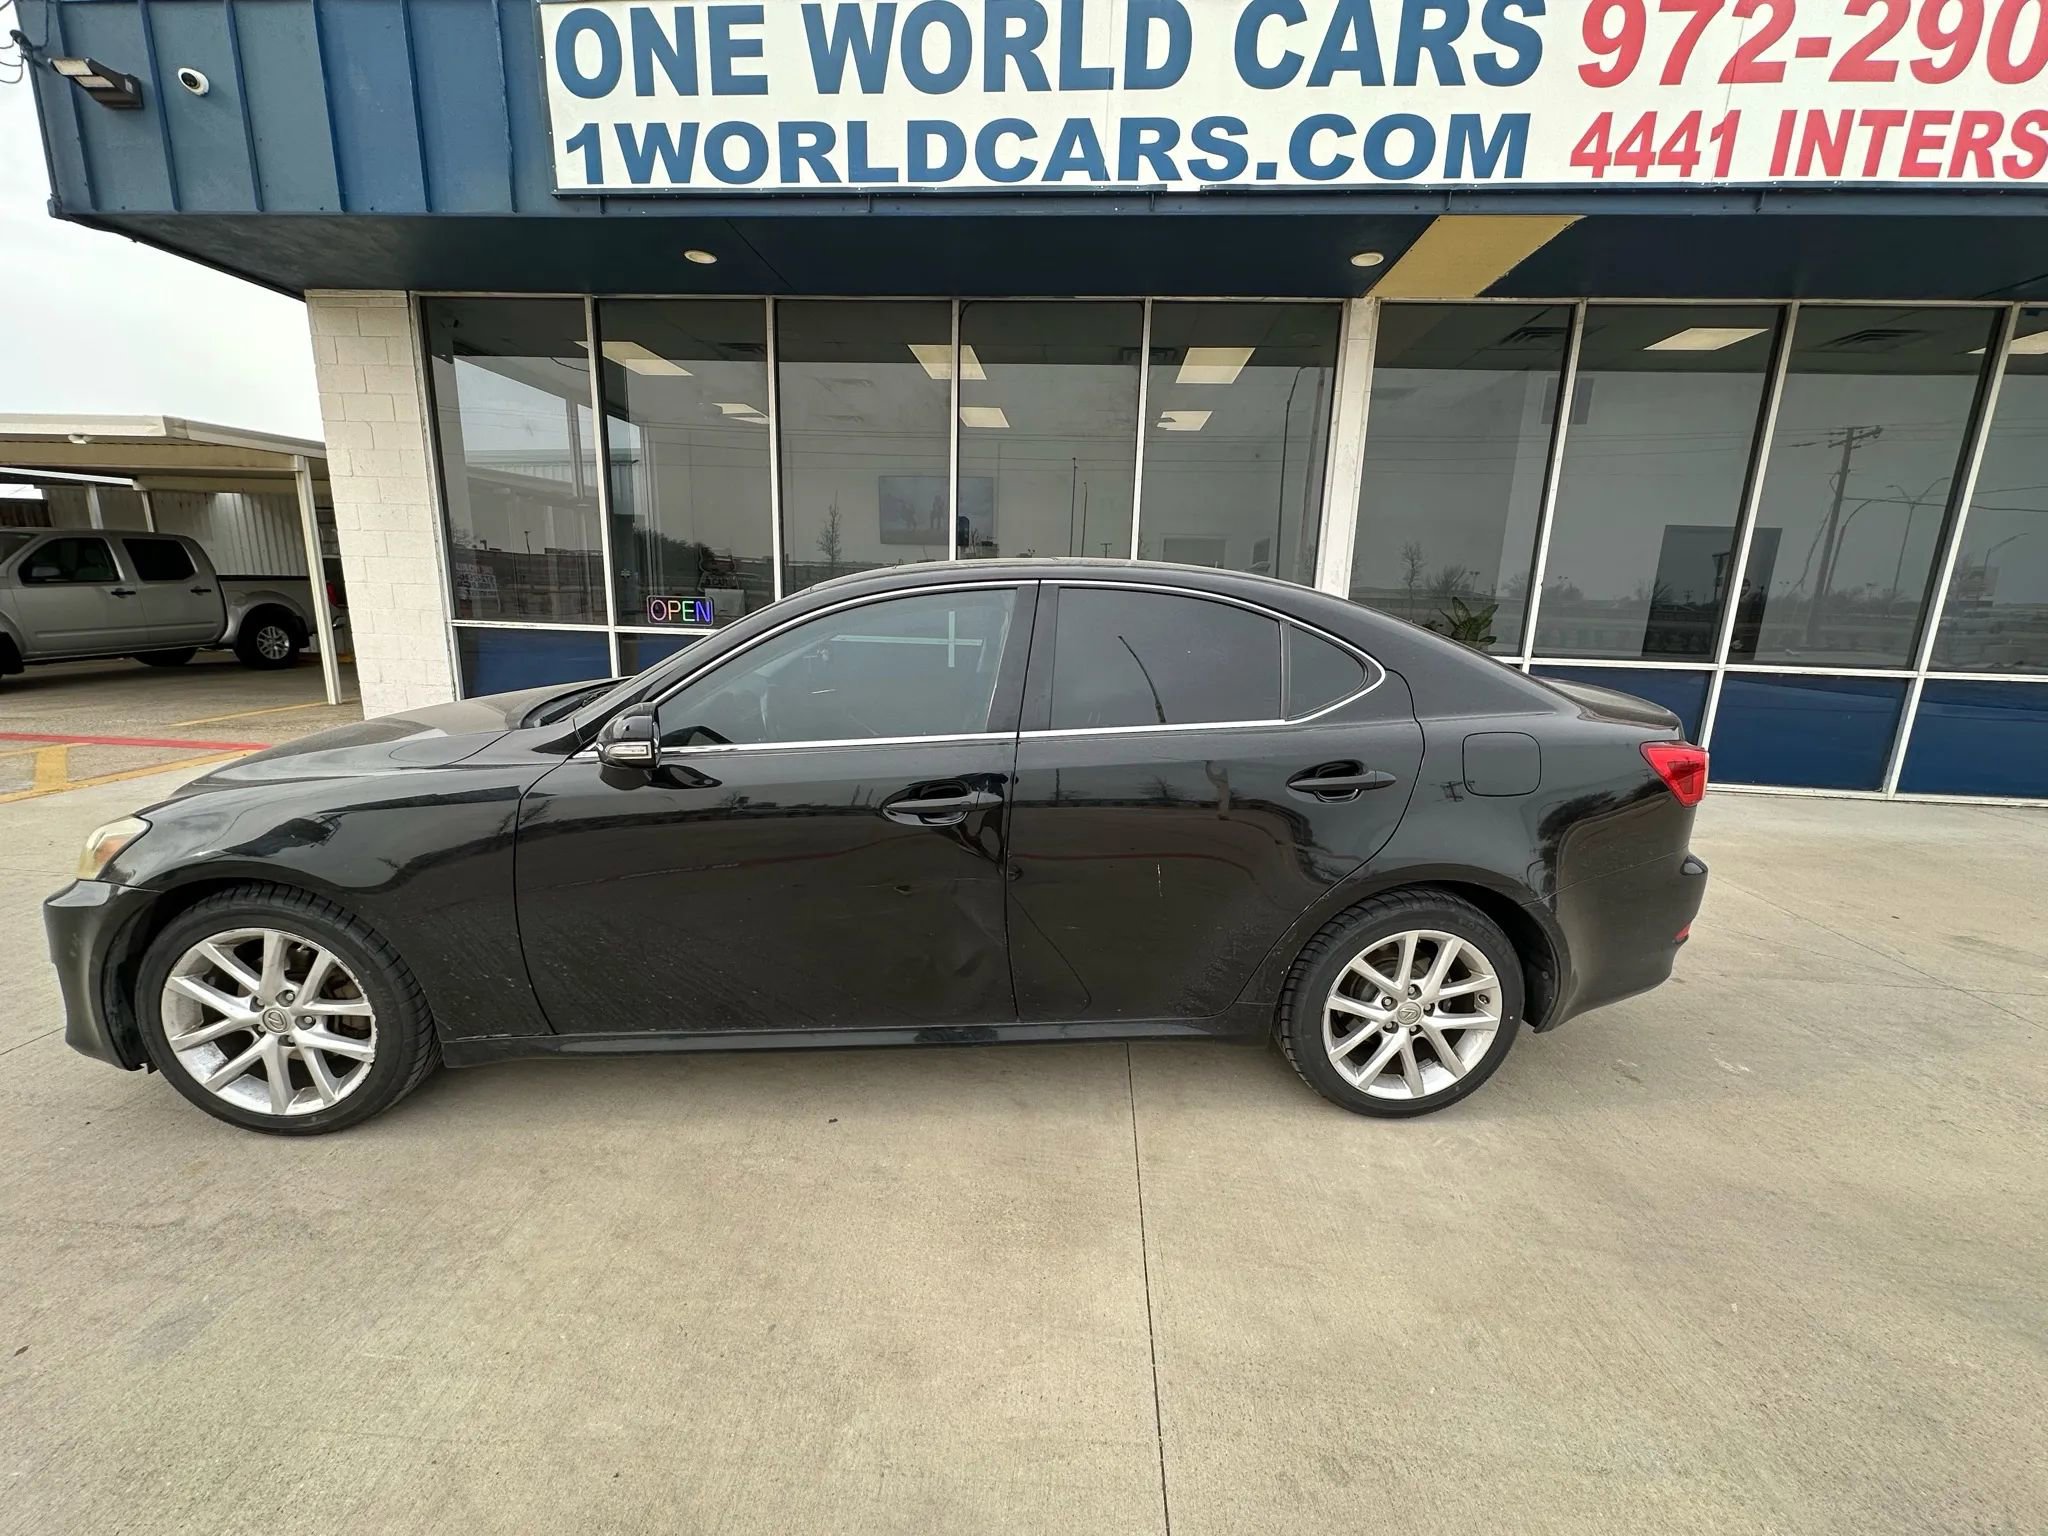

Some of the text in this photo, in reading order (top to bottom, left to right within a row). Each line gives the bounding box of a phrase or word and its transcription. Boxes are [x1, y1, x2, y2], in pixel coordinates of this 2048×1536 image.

[555, 0, 1545, 98] ONE WORLD CARS
[1578, 0, 2048, 87] 972-290
[565, 113, 1530, 184] 1WORLDCARS.COM
[1570, 109, 2048, 179] 4441 INTERS
[650, 600, 711, 622] OPEN
